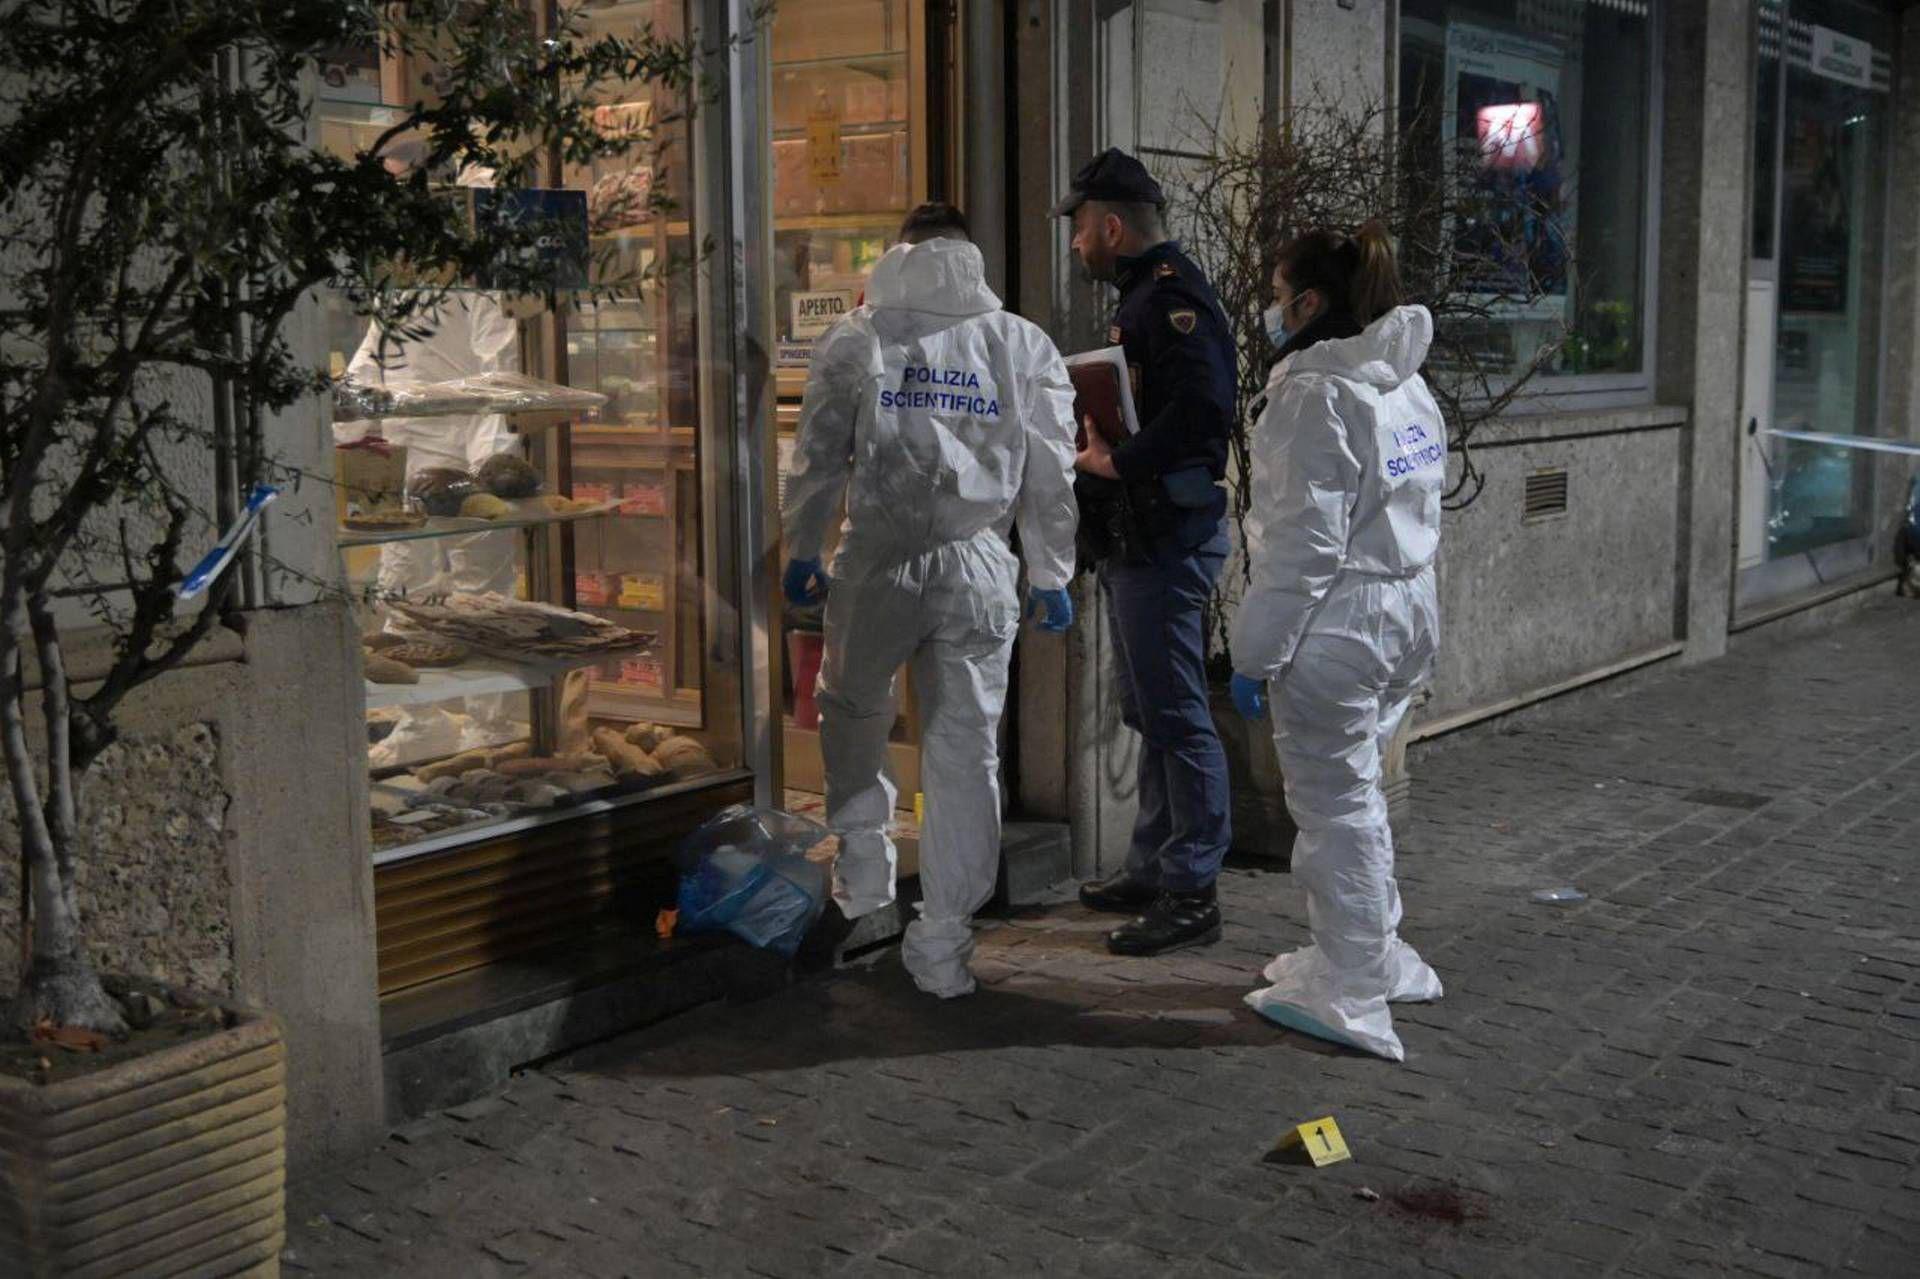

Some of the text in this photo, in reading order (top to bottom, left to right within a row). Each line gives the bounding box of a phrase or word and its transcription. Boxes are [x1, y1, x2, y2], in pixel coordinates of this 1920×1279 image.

[904, 366, 979, 389] POLIZIA
[880, 390, 1000, 416] SCIENTIFICA
[1315, 1126, 1332, 1152] 1
